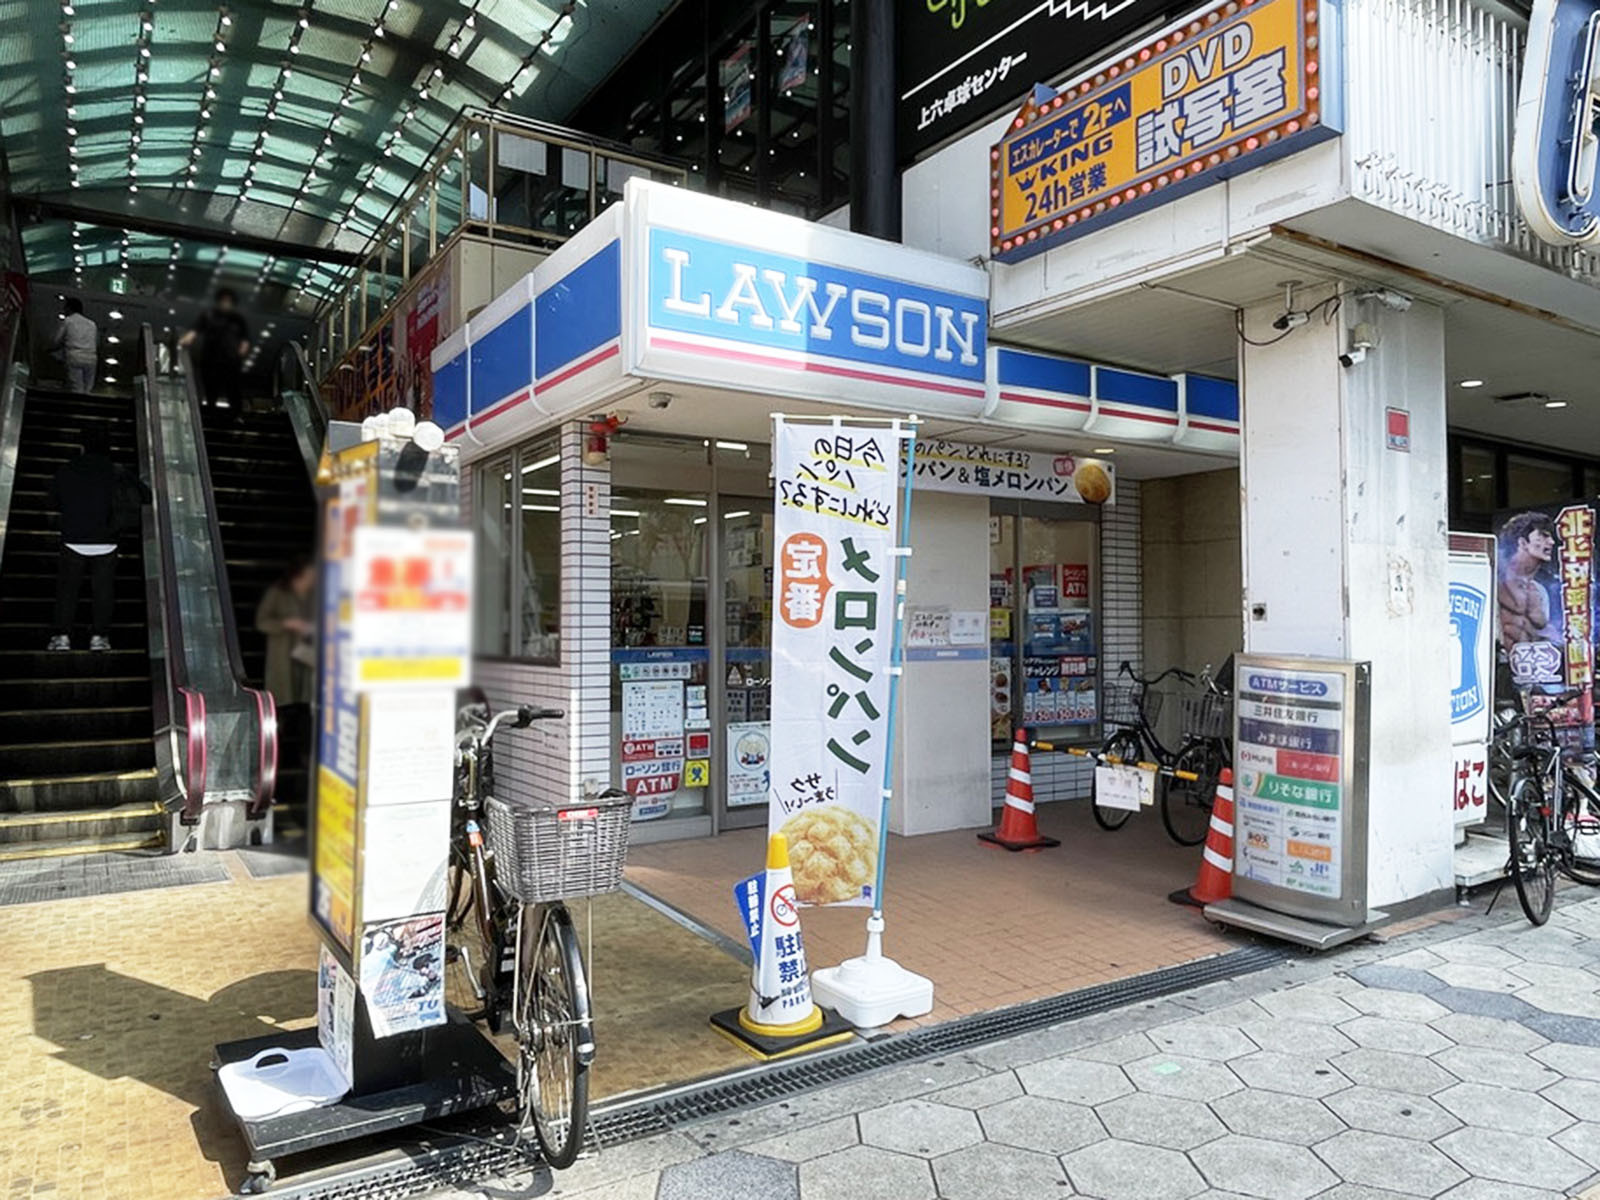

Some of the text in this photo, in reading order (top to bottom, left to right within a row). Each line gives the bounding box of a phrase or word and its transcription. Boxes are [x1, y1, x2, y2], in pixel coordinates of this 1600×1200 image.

[1161, 22, 1254, 99] DVD
[917, 52, 1027, 130] 上六卓球センター
[1136, 46, 1287, 173] 試写室
[1040, 132, 1114, 176] KING
[1024, 162, 1107, 223] 24h営業
[662, 247, 979, 366] LAWSON
[1251, 677, 1322, 694] ATMサービス
[1254, 705, 1318, 723] 三井住友銀行
[1257, 731, 1313, 749] みずほ銀行
[625, 760, 682, 776] ローソン銀行
[635, 776, 673, 794] ATM
[1268, 781, 1333, 803] りそな銀行
[775, 931, 802, 958] 駐
